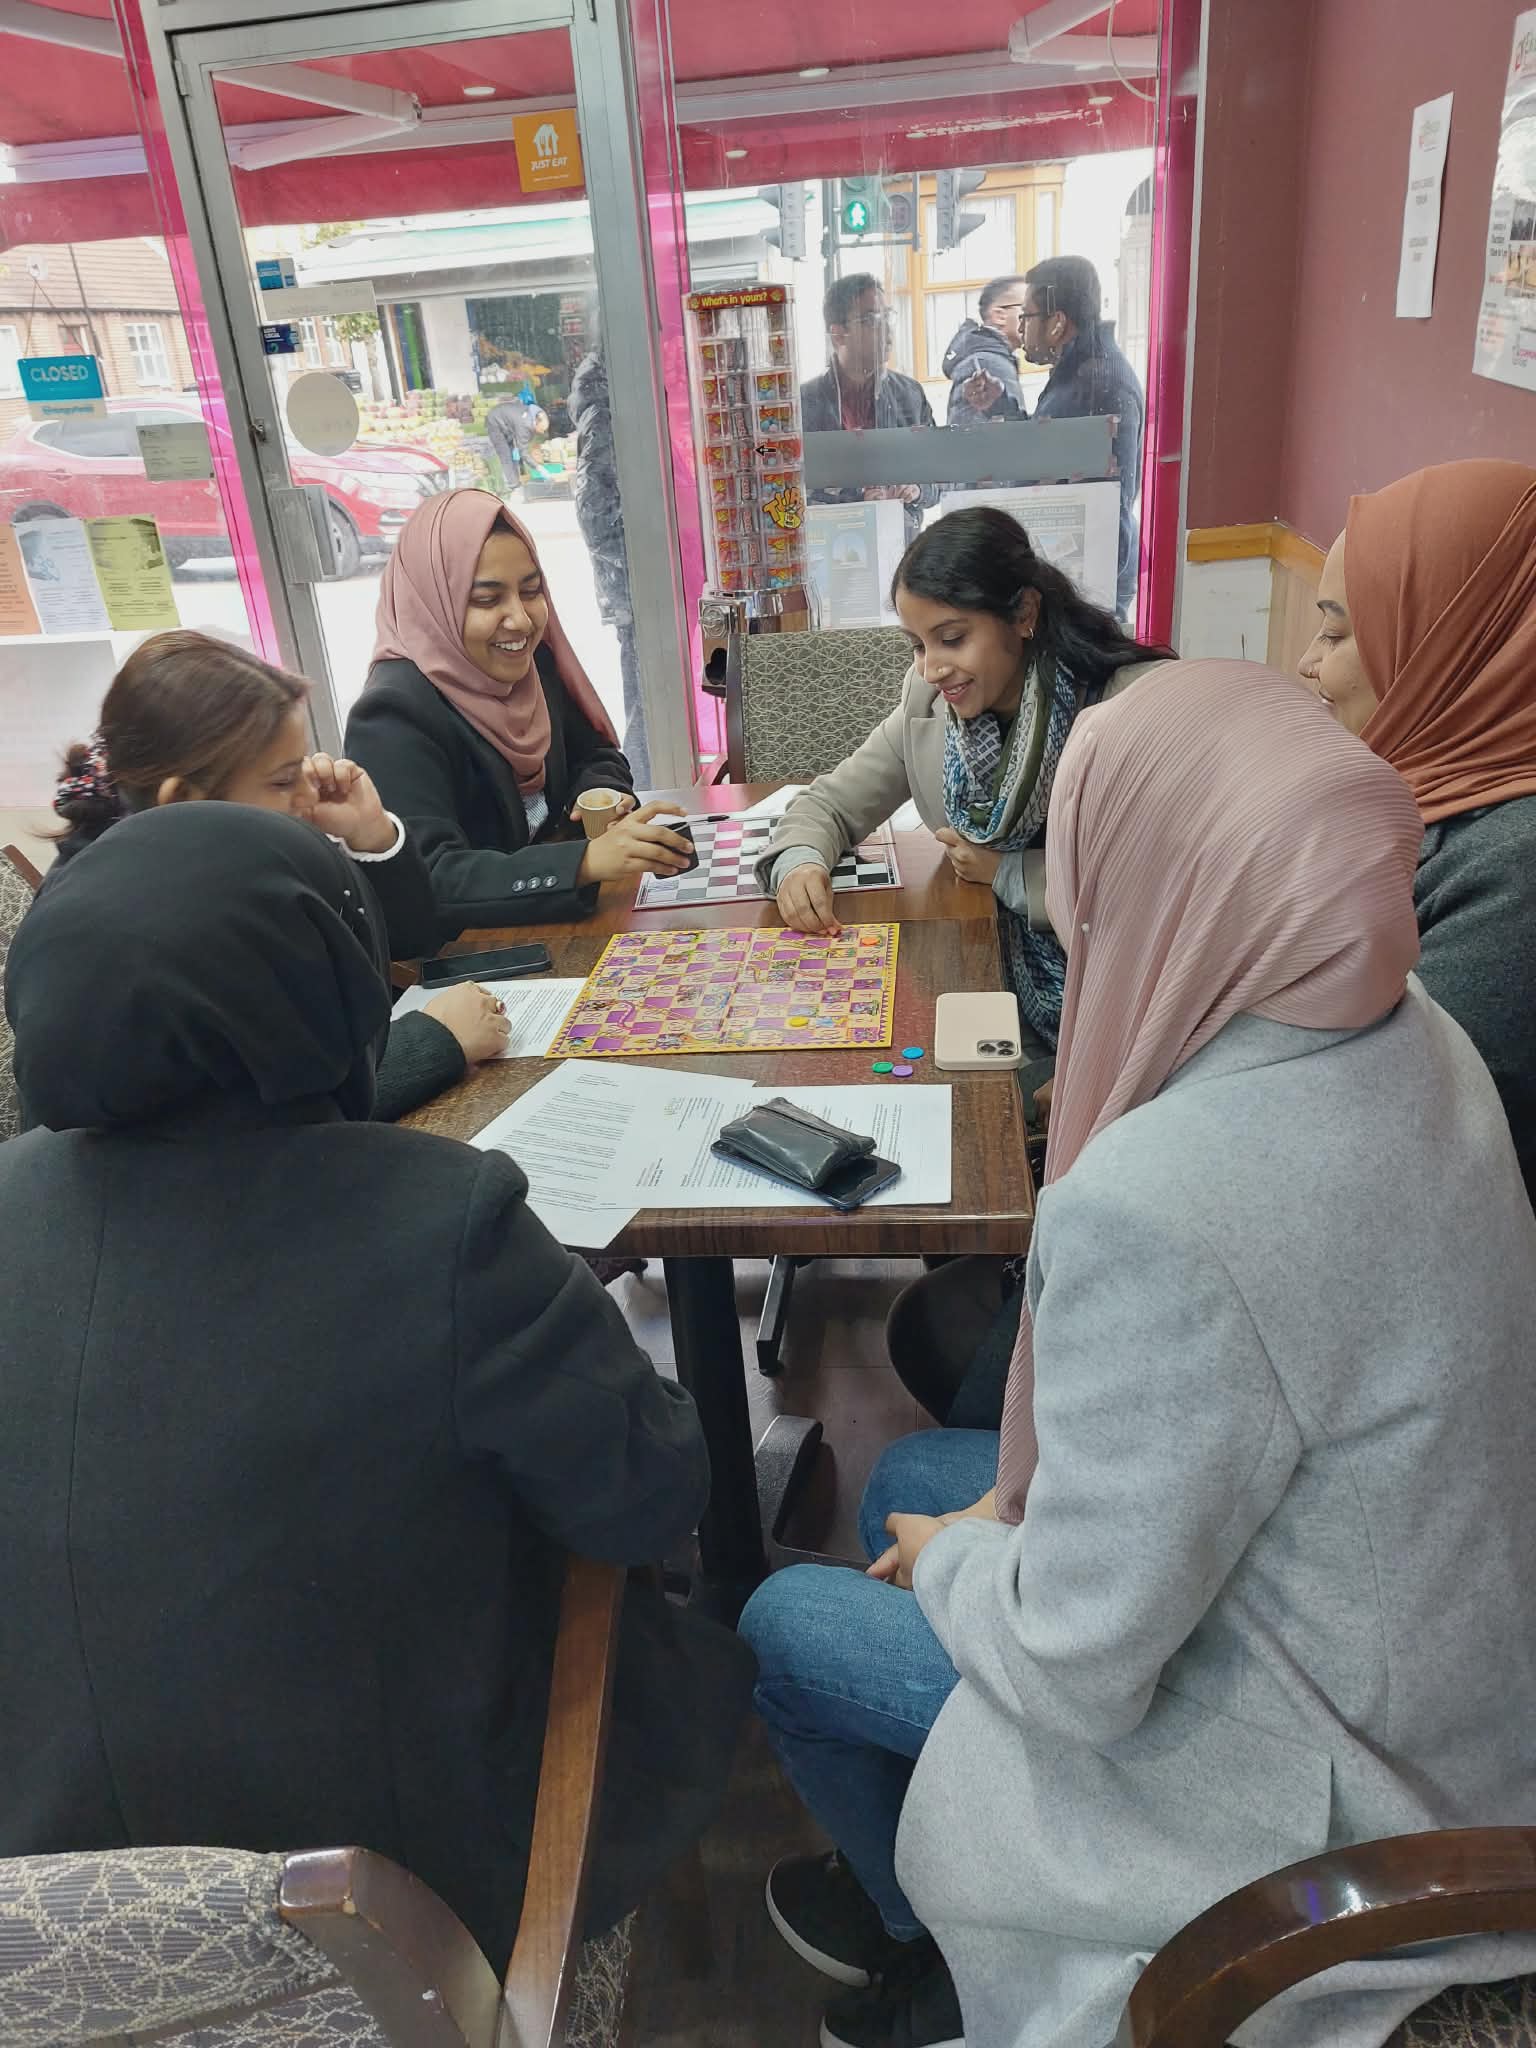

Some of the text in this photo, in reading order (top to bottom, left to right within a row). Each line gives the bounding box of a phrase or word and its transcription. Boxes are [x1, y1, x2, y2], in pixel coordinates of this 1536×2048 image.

[530, 157, 568, 172] JUST EAT
[701, 291, 768, 307] What's in yours?
[30, 365, 89, 382] CLOSED
